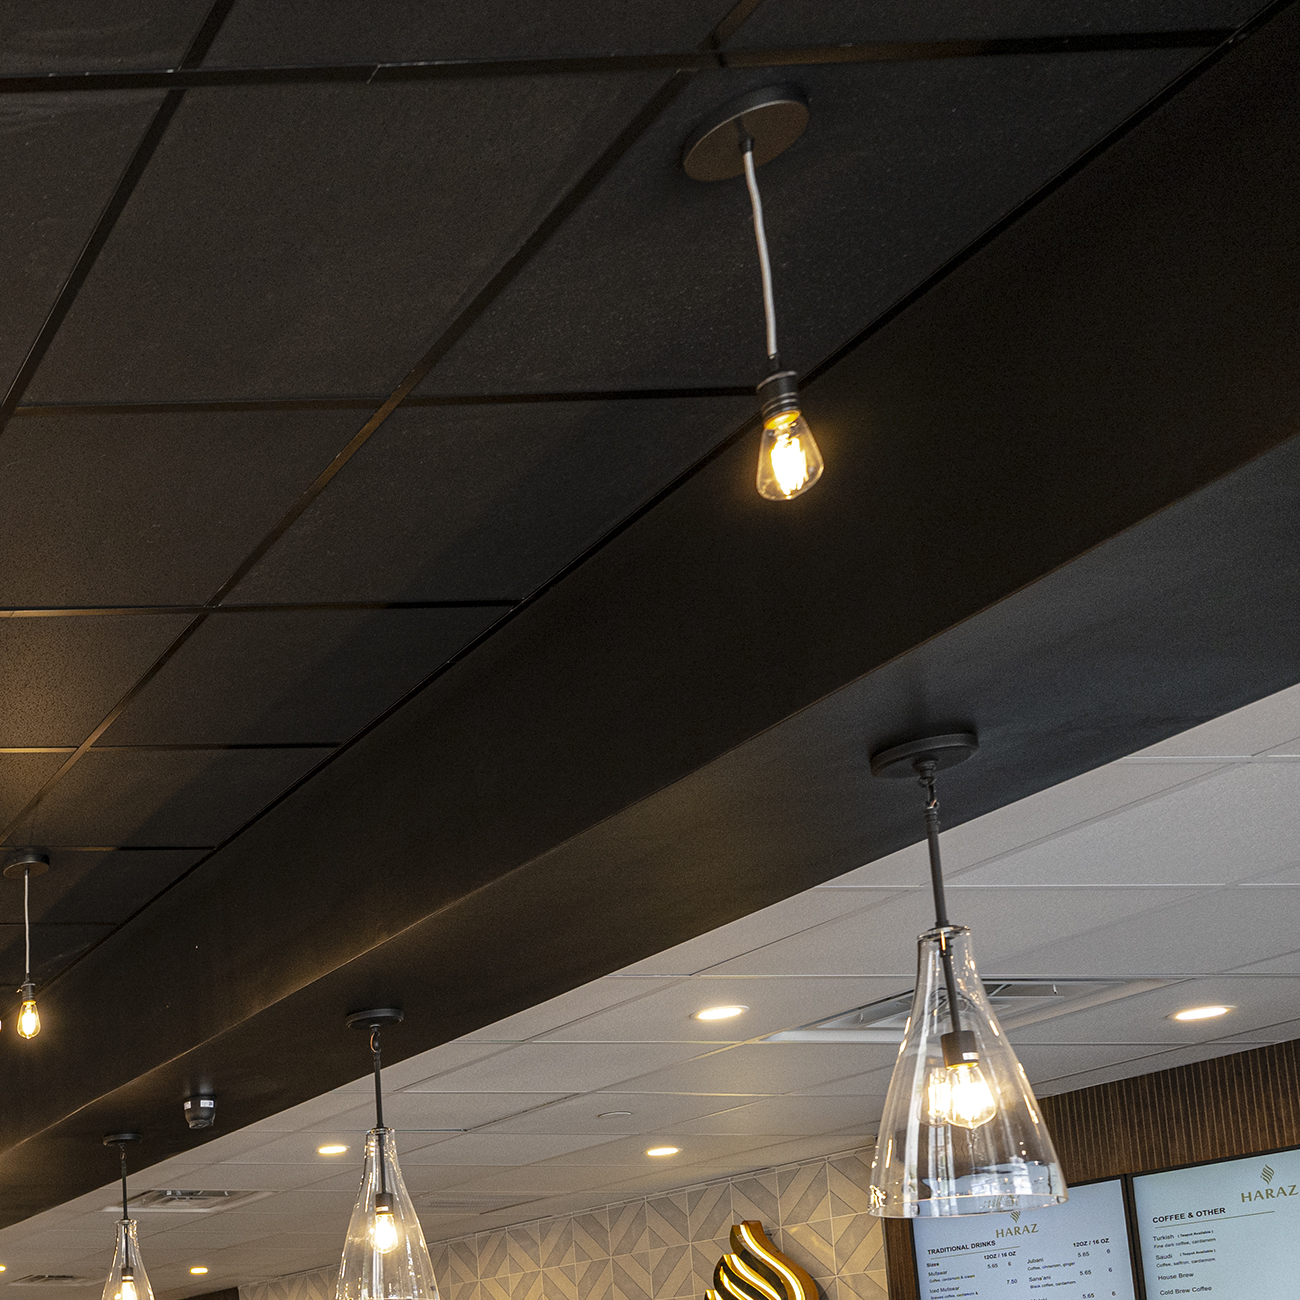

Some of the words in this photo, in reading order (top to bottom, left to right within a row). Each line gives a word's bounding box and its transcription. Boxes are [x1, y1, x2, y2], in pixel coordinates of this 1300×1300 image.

[1240, 1184, 1299, 1203] HARAZ
[1152, 1212, 1186, 1224] COFFEE
[1187, 1211, 1194, 1219] &
[1195, 1207, 1226, 1218] OTHER
[995, 1223, 1039, 1239] HARAZ
[1152, 1234, 1175, 1242] Turkish
[927, 1244, 970, 1255] TRADITIONAL
[970, 1240, 996, 1249] DRINKS
[1155, 1253, 1173, 1261] Saudi
